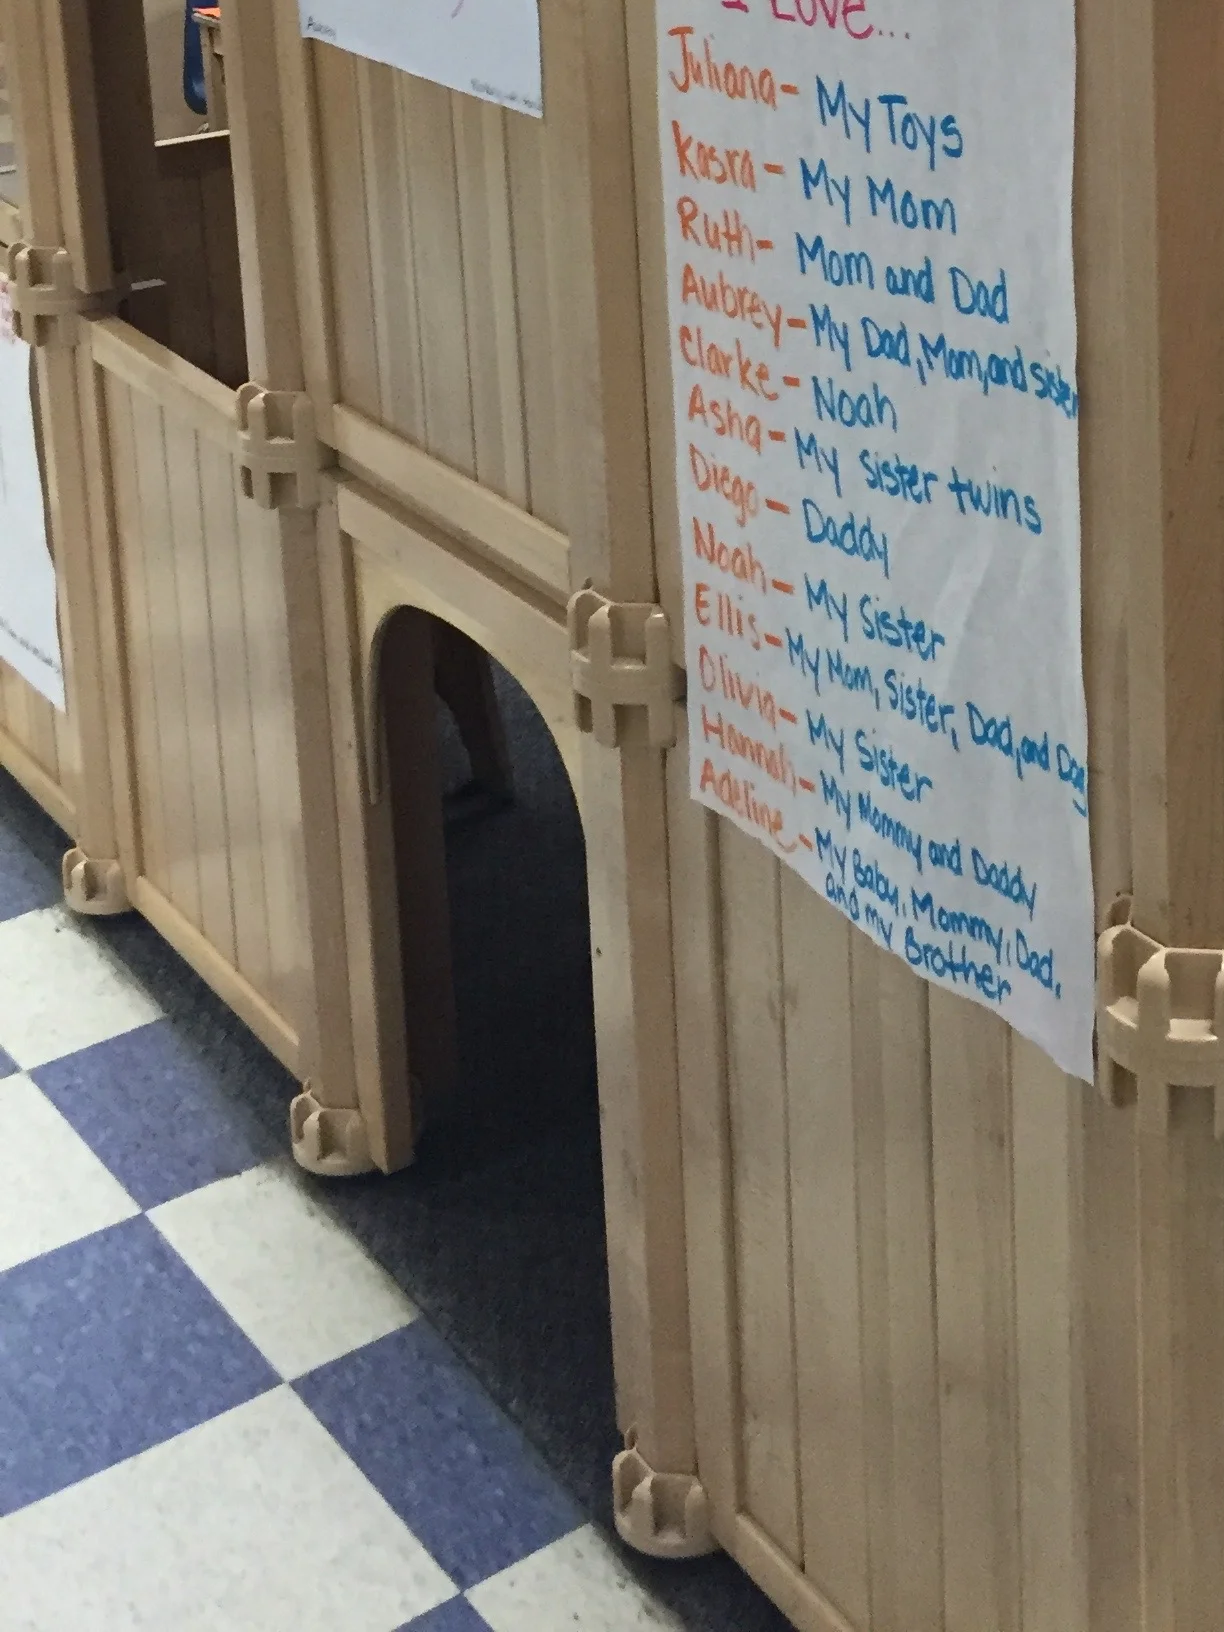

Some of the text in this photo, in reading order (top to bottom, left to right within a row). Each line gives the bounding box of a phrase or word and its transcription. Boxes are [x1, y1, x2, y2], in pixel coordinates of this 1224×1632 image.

[816, 74, 871, 153] My
[878, 95, 963, 171] Toys
[800, 158, 851, 226] My
[867, 175, 957, 235] Mom
[795, 232, 875, 290] Mom
[886, 256, 935, 304] and
[949, 266, 1009, 325] Dad
[809, 304, 852, 372] My
[812, 376, 897, 432] Noah
[794, 427, 841, 497] My
[947, 466, 1042, 535] twins
[802, 498, 889, 579] Daddy
[804, 573, 848, 642] My
[859, 593, 945, 661] Sister
[785, 628, 820, 696] My
[806, 710, 845, 774] My
[856, 728, 934, 803] Sister
[815, 828, 847, 880] My
[820, 770, 851, 830] My
[858, 792, 923, 875] Mommy
[929, 839, 963, 876] and
[971, 849, 1037, 921] Daddy
[825, 872, 1011, 1003] and my Brother
